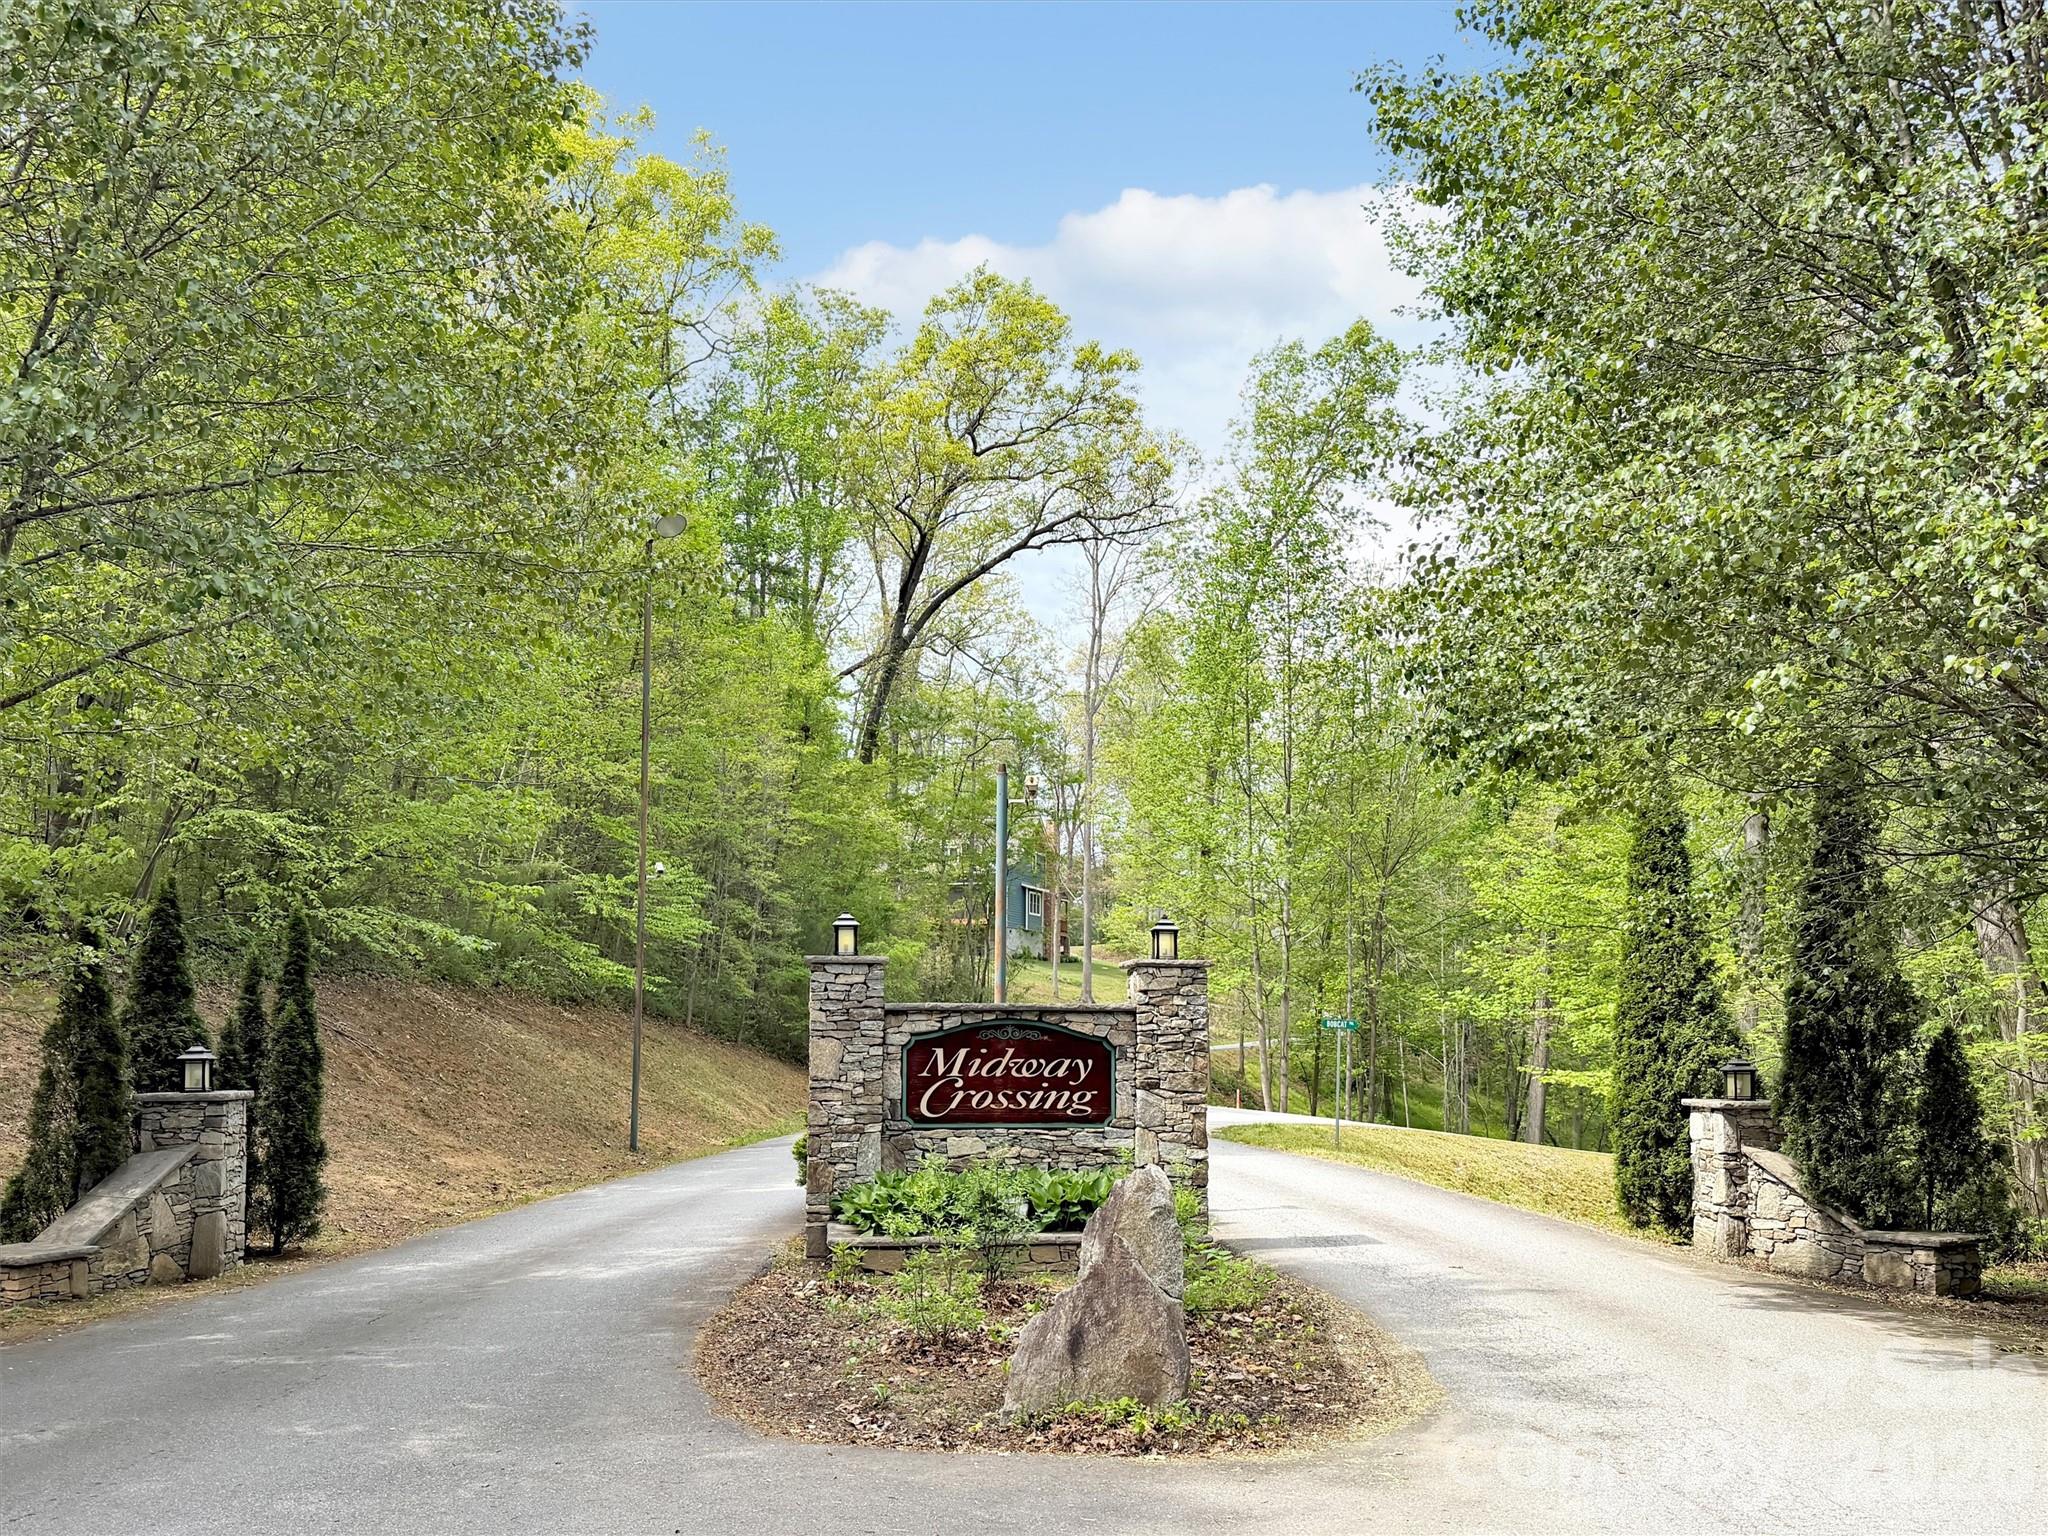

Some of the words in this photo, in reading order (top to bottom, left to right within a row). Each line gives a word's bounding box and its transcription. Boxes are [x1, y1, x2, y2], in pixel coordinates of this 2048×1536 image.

[1326, 1020, 1347, 1028] BOBCAT
[917, 1047, 1093, 1085] Midway
[919, 1077, 1098, 1118] Crossing
